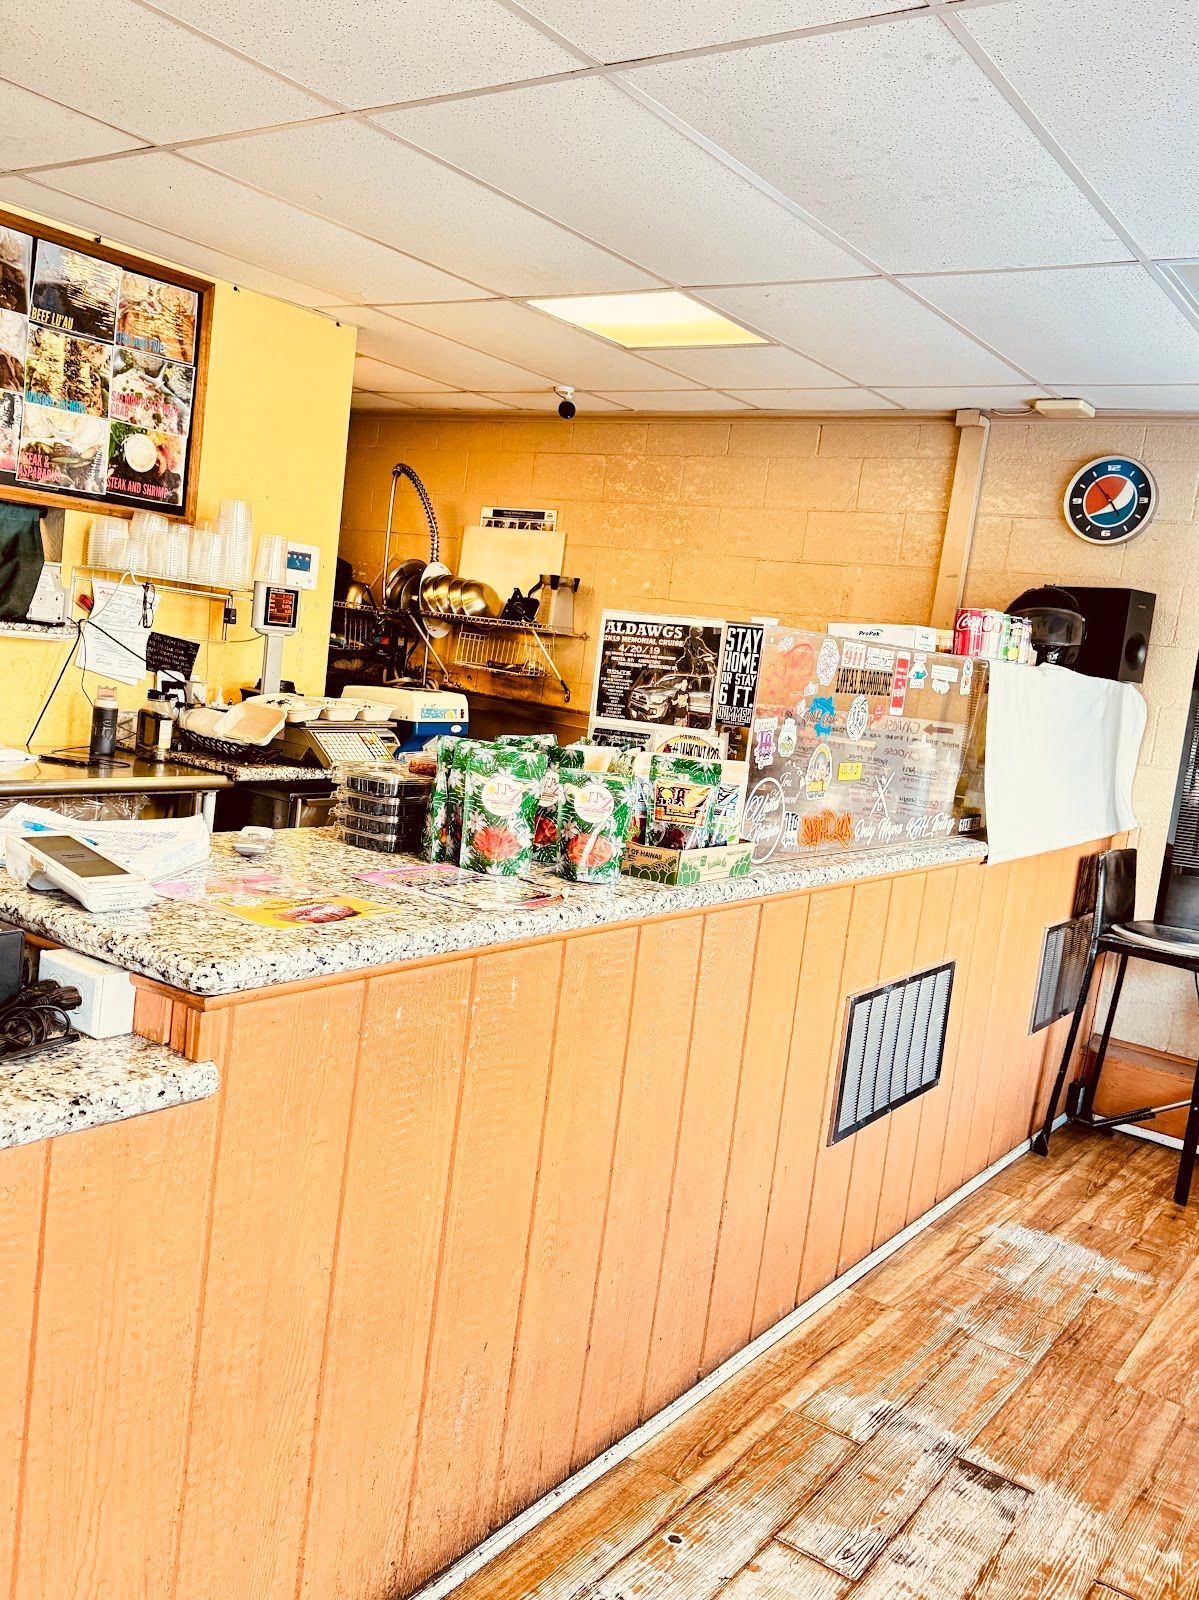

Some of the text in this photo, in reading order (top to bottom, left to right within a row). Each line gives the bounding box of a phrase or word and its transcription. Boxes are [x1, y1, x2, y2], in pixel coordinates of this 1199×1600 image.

[31, 308, 51, 325] BEEF
[110, 403, 129, 417] CRAB
[43, 457, 50, 469] &
[18, 467, 62, 483] ASPARAGUS
[107, 476, 170, 499] STEAK AND SHRIMP
[1072, 497, 1083, 505] 9
[606, 621, 683, 639] ALDAWGS
[622, 636, 657, 646] MEMORIAL
[658, 639, 684, 648] CRUISE
[726, 627, 763, 654] STAY
[619, 643, 660, 655] 4/20/19
[723, 651, 760, 675] HOME
[844, 649, 863, 666] 911
[721, 671, 757, 687] OR STAY
[718, 684, 755, 708] 6 FT.
[631, 847, 663, 861] OF HAWAII
